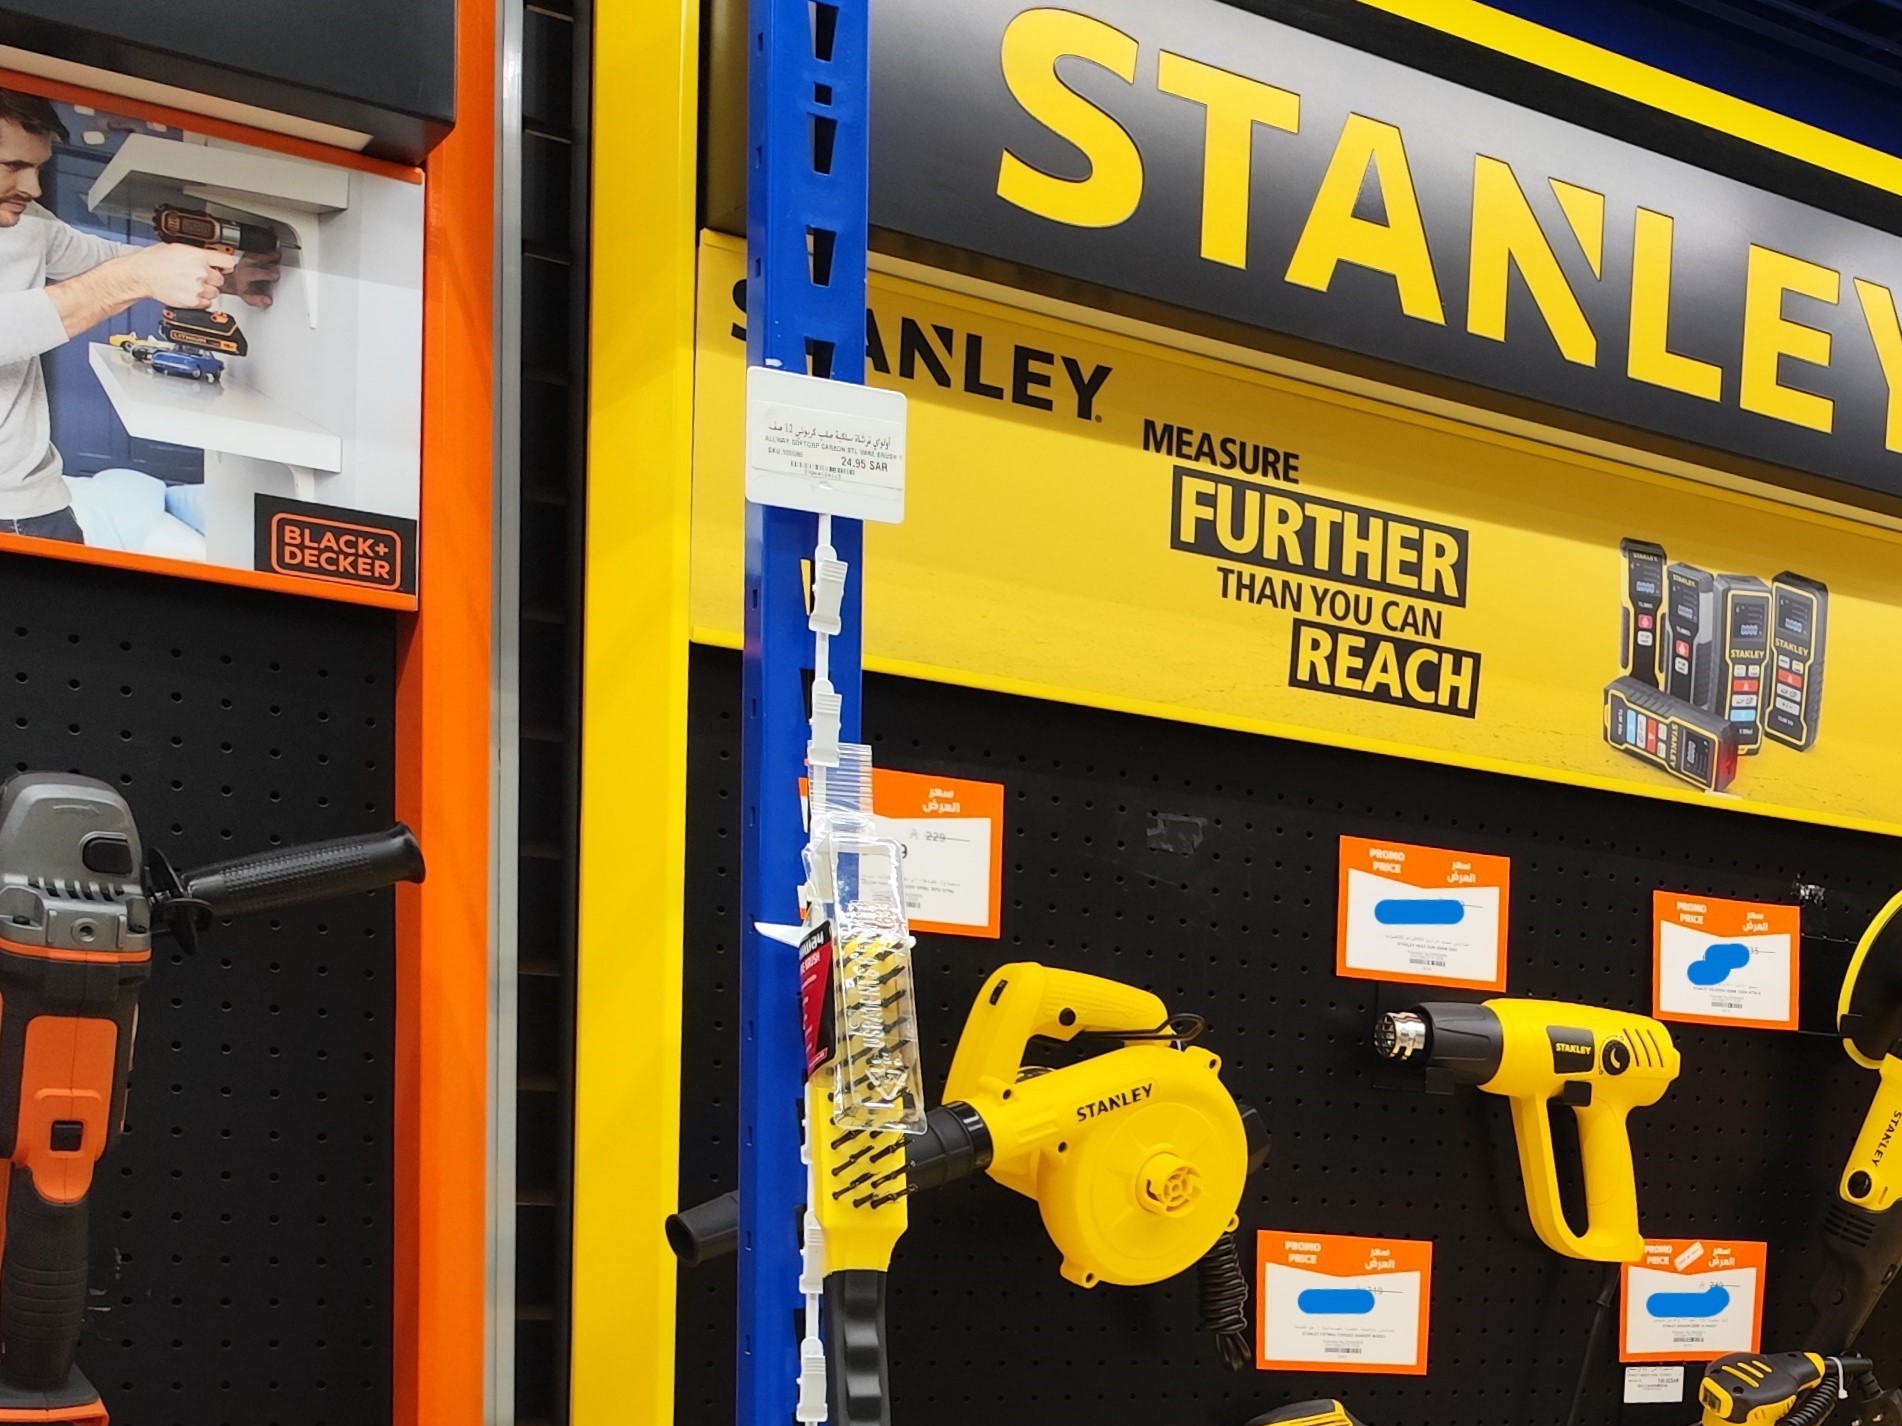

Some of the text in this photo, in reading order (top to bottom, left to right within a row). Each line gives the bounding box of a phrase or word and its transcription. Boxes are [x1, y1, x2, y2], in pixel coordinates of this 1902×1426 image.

[1143, 418, 1300, 484] MEASURE
[841, 456, 888, 472] 24.95 SAR
[284, 525, 389, 557] BLACK+
[1179, 474, 1460, 599] FURTHER
[284, 545, 390, 579] DECKER
[1217, 566, 1442, 640] THAN YOU CAN
[1297, 626, 1474, 711] REACH
[1369, 847, 1406, 863] PROMO
[1372, 861, 1402, 875] PRICE
[1676, 901, 1707, 914] PROMO
[1679, 912, 1704, 925] PRICE
[1555, 1042, 1591, 1056] STANLEY
[1076, 1083, 1153, 1124] STANLEY
[1873, 1110, 1902, 1168] STANLEY
[1285, 1241, 1322, 1252] PROMO
[1644, 1243, 1673, 1255] PROMO
[1288, 1253, 1318, 1264] PRICE
[1646, 1255, 1670, 1266] PRICE
